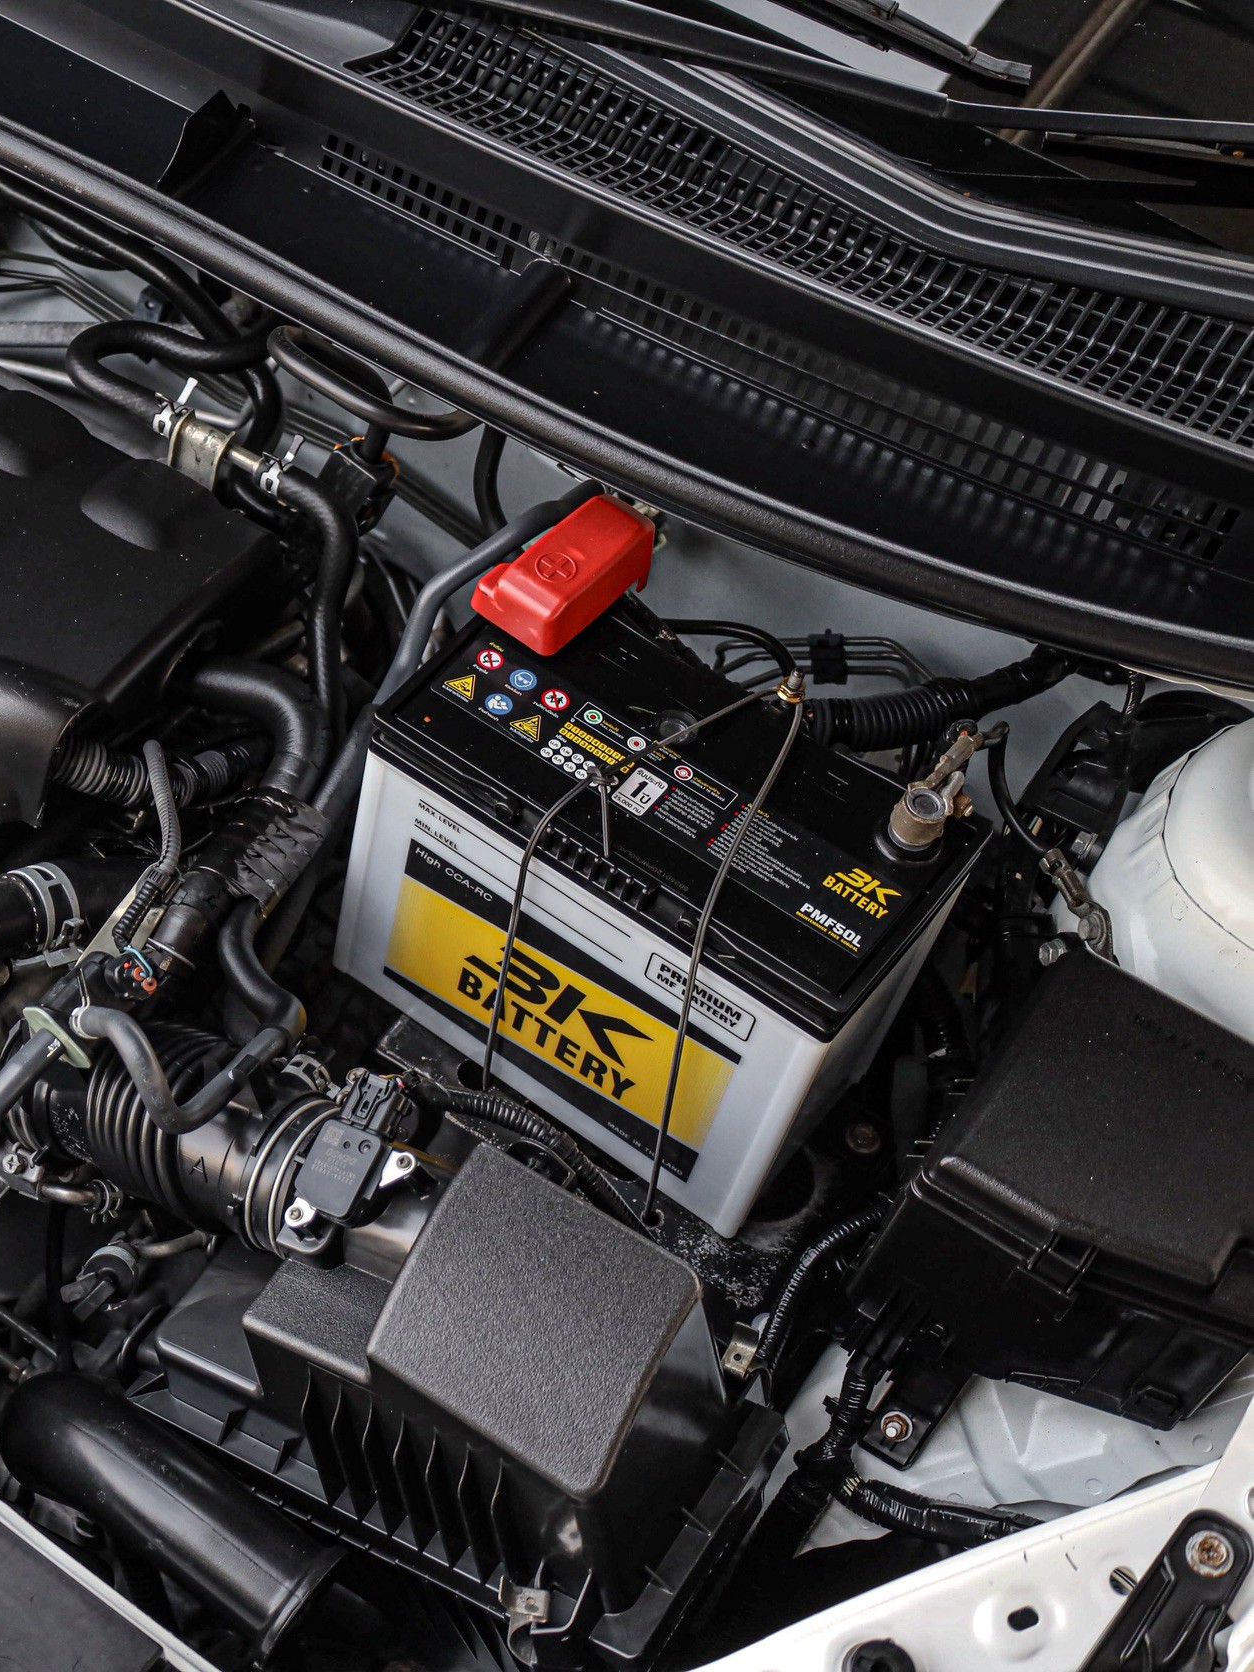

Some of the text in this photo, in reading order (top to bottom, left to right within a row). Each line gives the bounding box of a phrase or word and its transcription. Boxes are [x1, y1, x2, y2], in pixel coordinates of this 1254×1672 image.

[630, 781, 652, 804] 1 ปี
[636, 769, 666, 790] รับประกัน
[414, 818, 459, 849] MIN. LEVEL
[418, 802, 461, 834] MAX. LEVEL
[415, 846, 494, 902] High CCA-RC
[835, 868, 902, 906] 3K
[822, 875, 888, 919] BATTERY
[796, 911, 827, 932] MAINTENANCE
[828, 930, 840, 940] FREE
[657, 973, 677, 988] MF
[464, 946, 654, 1068] 3K
[457, 967, 636, 1101] BATTERY
[606, 1121, 629, 1139] MADE
[189, 1155, 208, 1183] A
